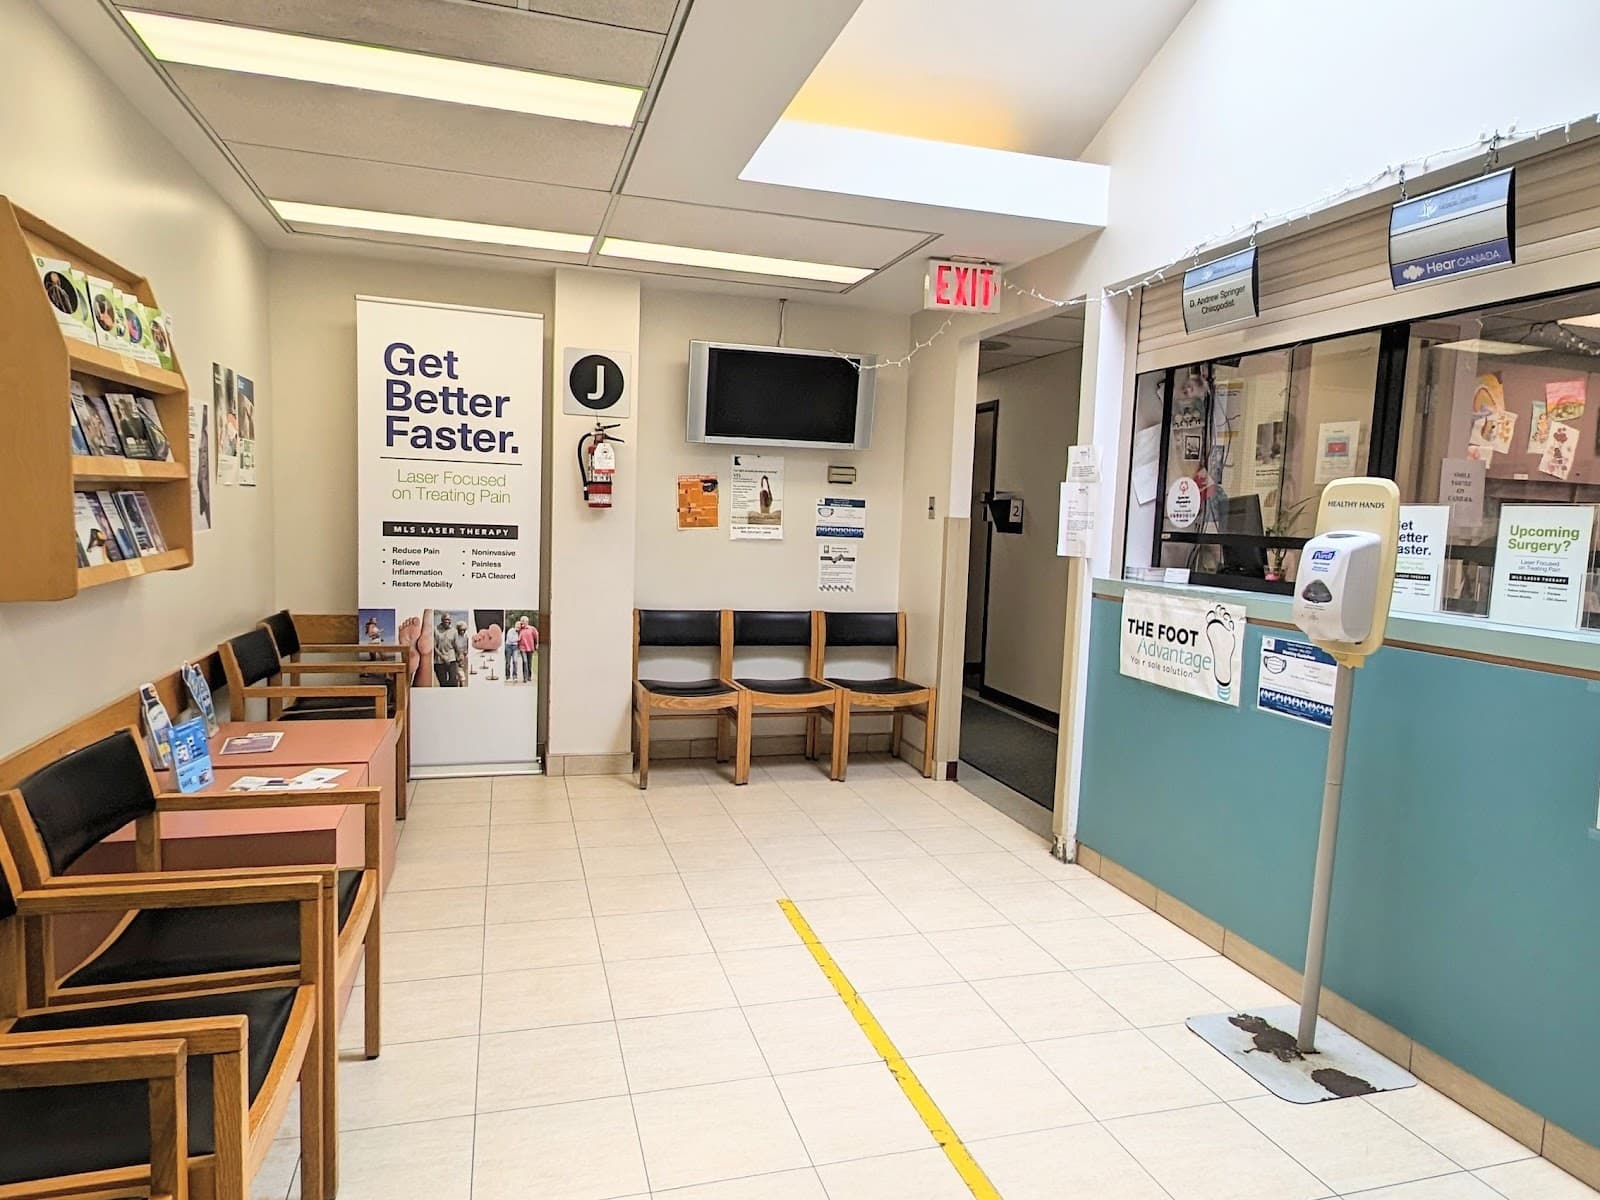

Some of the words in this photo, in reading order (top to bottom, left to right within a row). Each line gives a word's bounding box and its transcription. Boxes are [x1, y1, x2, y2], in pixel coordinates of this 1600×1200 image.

[1426, 258, 1456, 274] Hear
[1456, 249, 1500, 267] CANADA
[936, 265, 993, 308] EXIT
[384, 342, 459, 380] Get
[586, 365, 605, 401] J
[386, 378, 511, 418] Better
[386, 415, 519, 454] Faster.
[397, 468, 440, 485] Laser
[443, 471, 506, 487] Focused
[392, 487, 411, 500] on
[415, 486, 475, 506] Treating
[480, 489, 511, 504] Pain
[1013, 505, 1020, 517] 2
[1328, 500, 1358, 509] HEALTHY
[1359, 501, 1385, 509] HANDS
[393, 526, 416, 534] MLS
[421, 526, 455, 535] LASER
[460, 527, 509, 537] THERAPY
[1399, 520, 1413, 531] et
[1399, 532, 1429, 543] etter
[1510, 524, 1580, 541] Upcoming
[392, 546, 421, 554] Reduce
[423, 547, 440, 555] Pain
[1397, 544, 1431, 556] aster.
[1508, 538, 1571, 554] Surgery?
[471, 549, 516, 557] Noninvasive
[392, 559, 420, 567] Relieve
[471, 560, 502, 568] Painless
[392, 568, 443, 576] Inflammation
[488, 572, 516, 580] Cleared
[392, 580, 421, 588] Restore
[423, 581, 453, 590] Mobility
[1127, 618, 1154, 638] THE
[1158, 624, 1199, 647] FOOT
[1137, 638, 1212, 674] Advantage
[1162, 663, 1193, 678] solution
